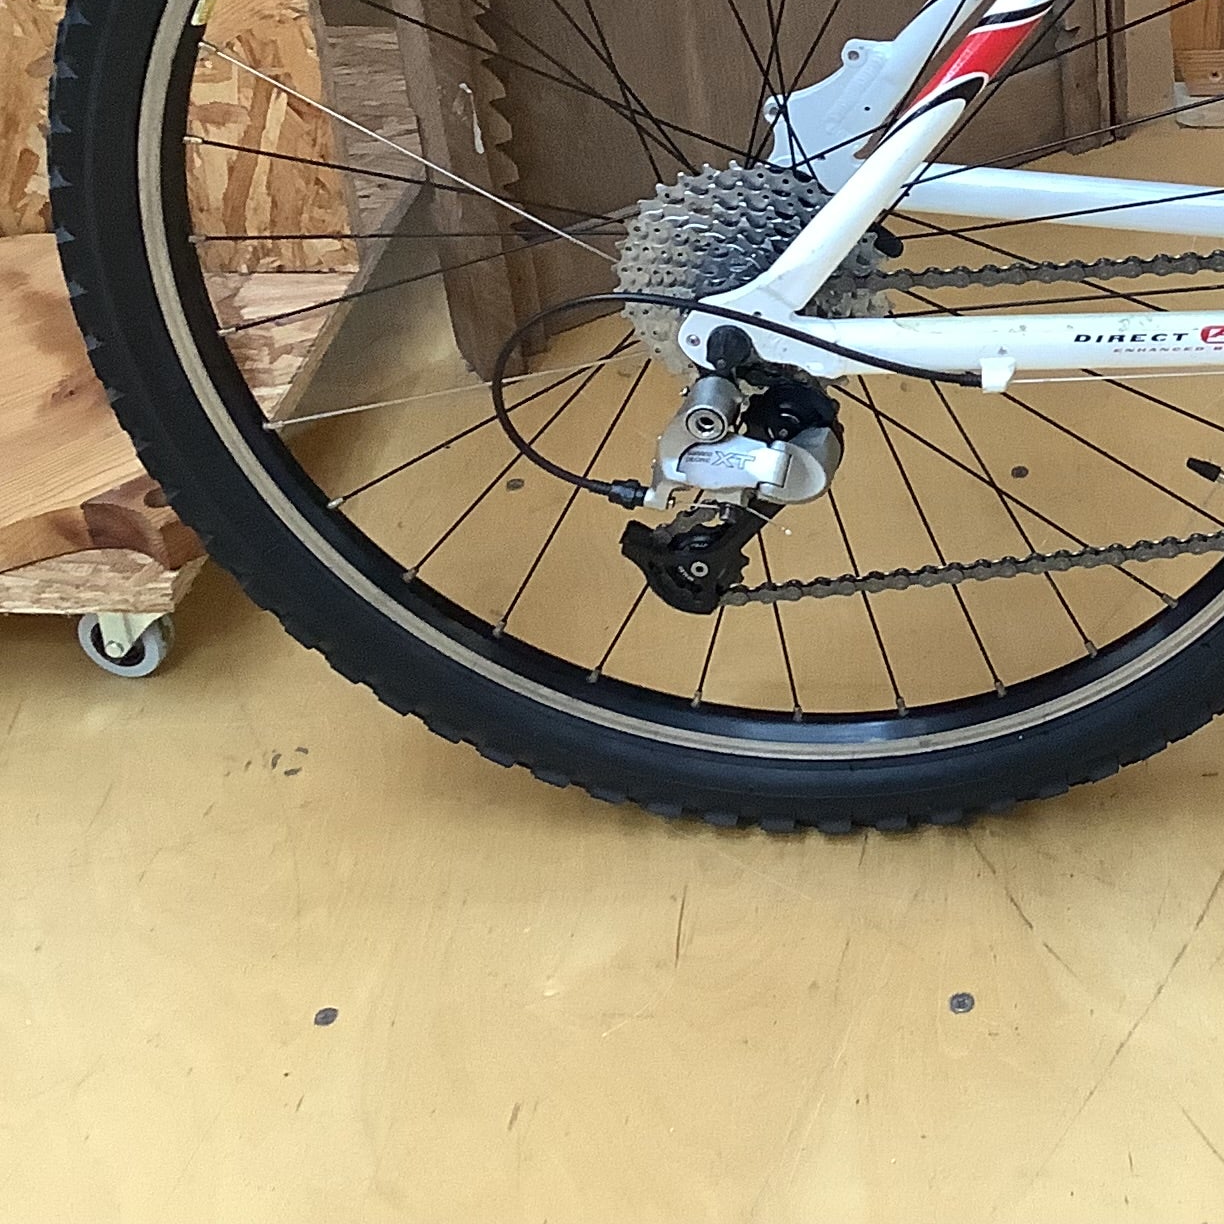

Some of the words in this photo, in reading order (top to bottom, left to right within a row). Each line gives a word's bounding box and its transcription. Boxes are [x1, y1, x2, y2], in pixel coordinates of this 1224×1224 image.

[1073, 332, 1189, 343] DIRECT
[1113, 345, 1205, 353] ENHANCED
[711, 450, 757, 471] XT
